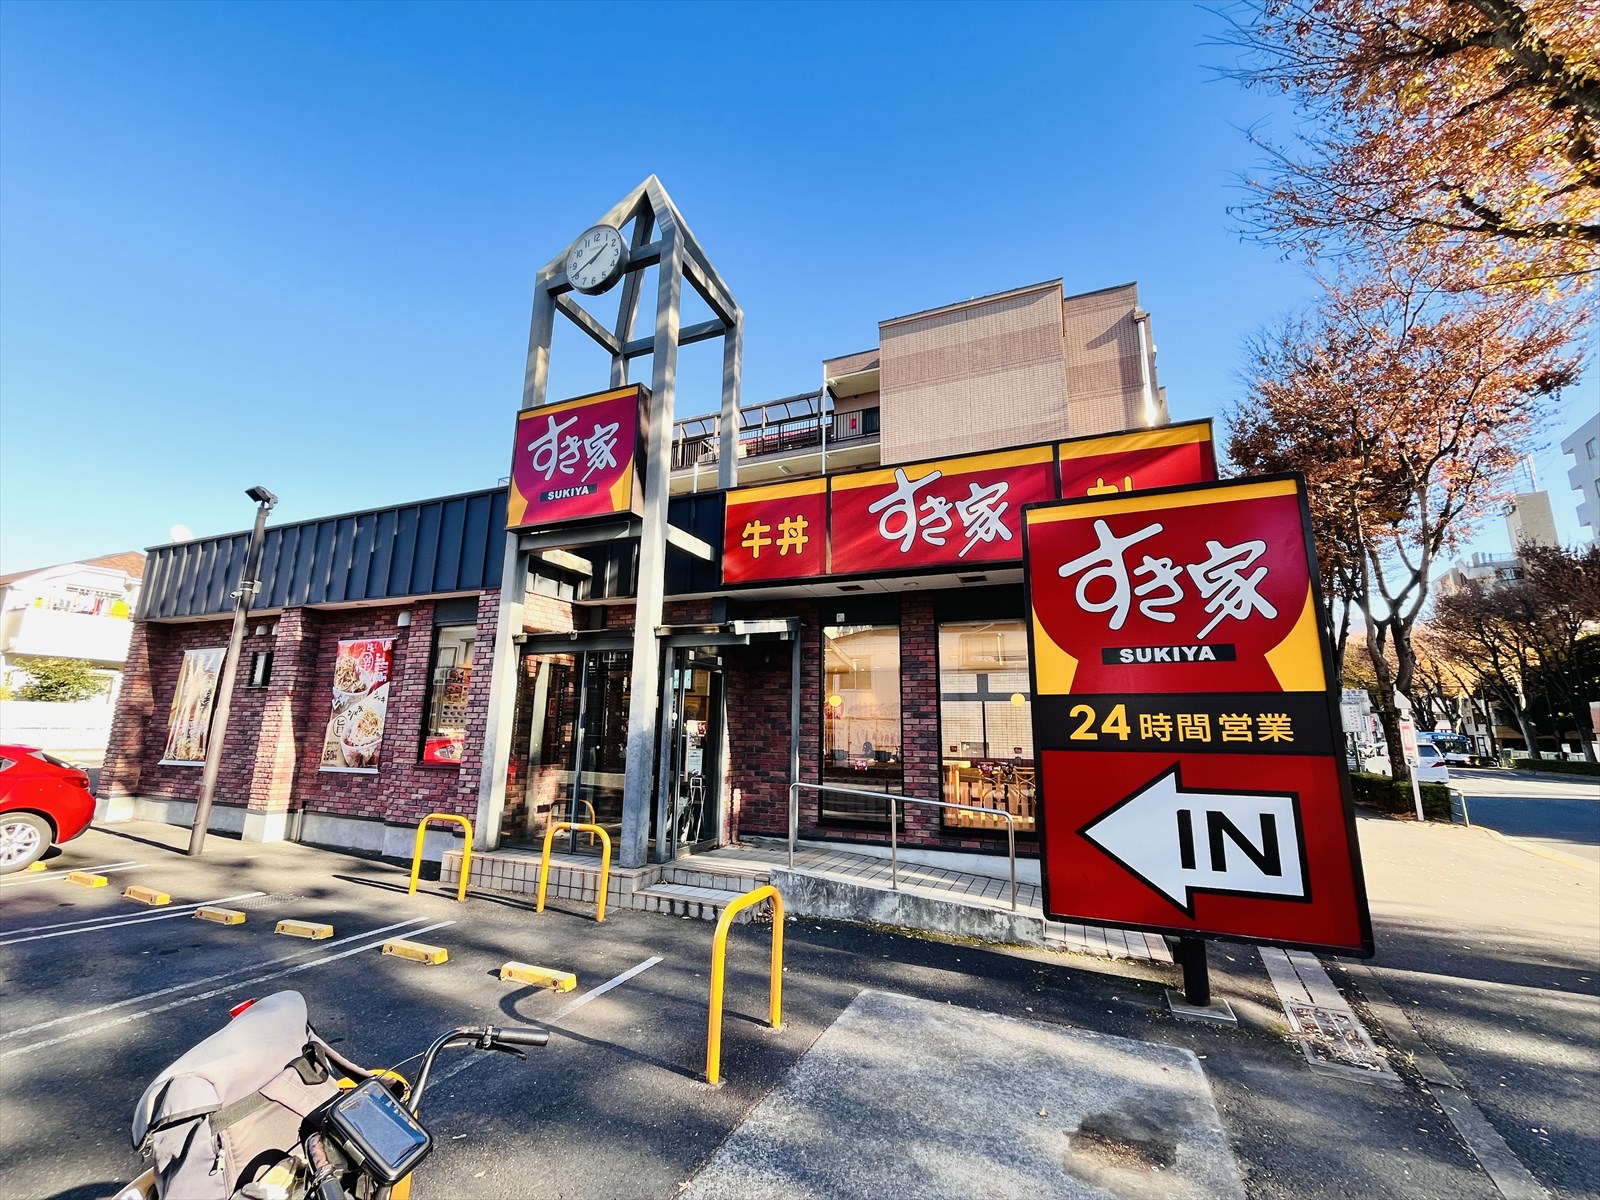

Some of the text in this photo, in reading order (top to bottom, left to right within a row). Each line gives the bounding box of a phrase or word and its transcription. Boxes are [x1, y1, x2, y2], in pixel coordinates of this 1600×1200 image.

[594, 234, 601, 242] 12
[611, 239, 616, 247] 2
[577, 250, 583, 258] 10
[573, 262, 578, 270] 9
[583, 277, 588, 285] 7
[592, 277, 596, 285] 6
[602, 271, 607, 279] 5
[527, 415, 621, 483] すき家
[547, 485, 590, 501] SUKIYA
[867, 465, 1014, 558] すき家
[741, 514, 809, 558] 牛丼
[1057, 518, 1279, 641] すき家
[1119, 645, 1217, 664] SUKIYA
[1069, 704, 1295, 743] 24時間営業
[1176, 809, 1282, 877] IN
